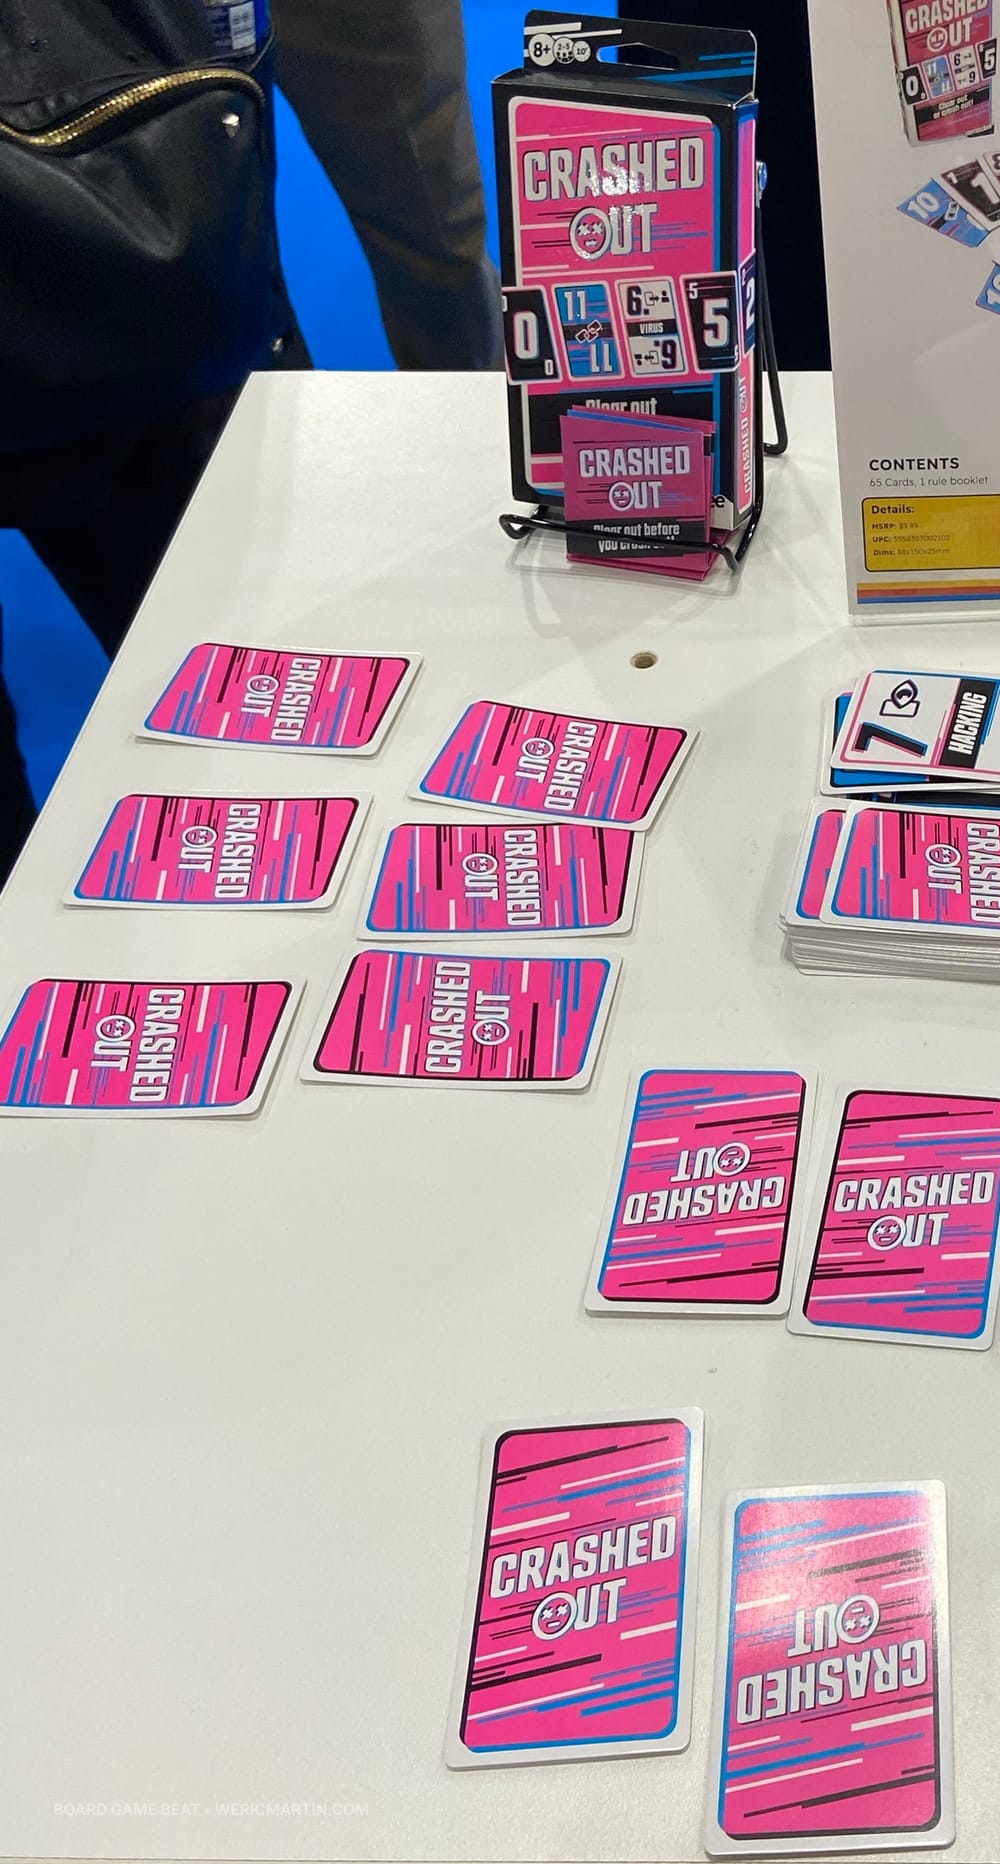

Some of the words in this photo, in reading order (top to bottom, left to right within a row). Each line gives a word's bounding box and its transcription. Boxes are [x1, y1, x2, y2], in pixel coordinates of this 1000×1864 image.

[533, 42, 551, 57] 8+
[927, 17, 973, 52] OUT
[983, 48, 995, 70] 5
[905, 75, 919, 96] 0
[523, 136, 705, 202] CRASHED
[970, 171, 1000, 205] 1
[907, 191, 940, 220] 10
[569, 202, 658, 261] OUT
[564, 290, 586, 321] 11
[688, 282, 698, 300] 5
[512, 311, 539, 360] 0
[639, 322, 664, 335] VIRUS
[702, 298, 730, 349] 5
[589, 343, 613, 373] 11
[579, 445, 690, 478] CRASHED
[741, 417, 752, 494] CRASHED
[869, 457, 960, 471] CONTENTS
[609, 480, 662, 512] OUT
[869, 478, 882, 487] 65
[885, 476, 917, 489] Cards,
[928, 477, 948, 486] rule
[951, 475, 989, 486] booklet
[644, 522, 680, 536] before
[871, 504, 915, 514] Details:
[872, 522, 898, 531] MSRP:
[872, 534, 892, 543] UPC:
[873, 548, 895, 557] Dims:
[241, 674, 280, 718] OUT
[270, 657, 322, 741] CRASHED
[851, 722, 928, 758] 7
[947, 691, 988, 755] HACKING
[514, 737, 555, 783] OUT
[544, 720, 599, 811] CRASHED
[178, 825, 218, 874] OUT
[214, 802, 262, 898] CRASHED
[924, 843, 964, 894] OUT
[462, 853, 499, 901] OUT
[504, 829, 542, 926] CRASHED
[423, 960, 473, 1074] CRASHED
[471, 990, 511, 1046] OUT
[90, 1015, 136, 1073] OUT
[128, 987, 186, 1102] CRASHED
[670, 1142, 752, 1183] OUT
[622, 1176, 786, 1227] CRASHED
[834, 1171, 995, 1214] CRASHED
[866, 1212, 949, 1253] OUT
[489, 1514, 678, 1601] CRASHED
[531, 1576, 627, 1641] OUT
[786, 1593, 881, 1659] OUT
[735, 1638, 929, 1726] CRASHED
